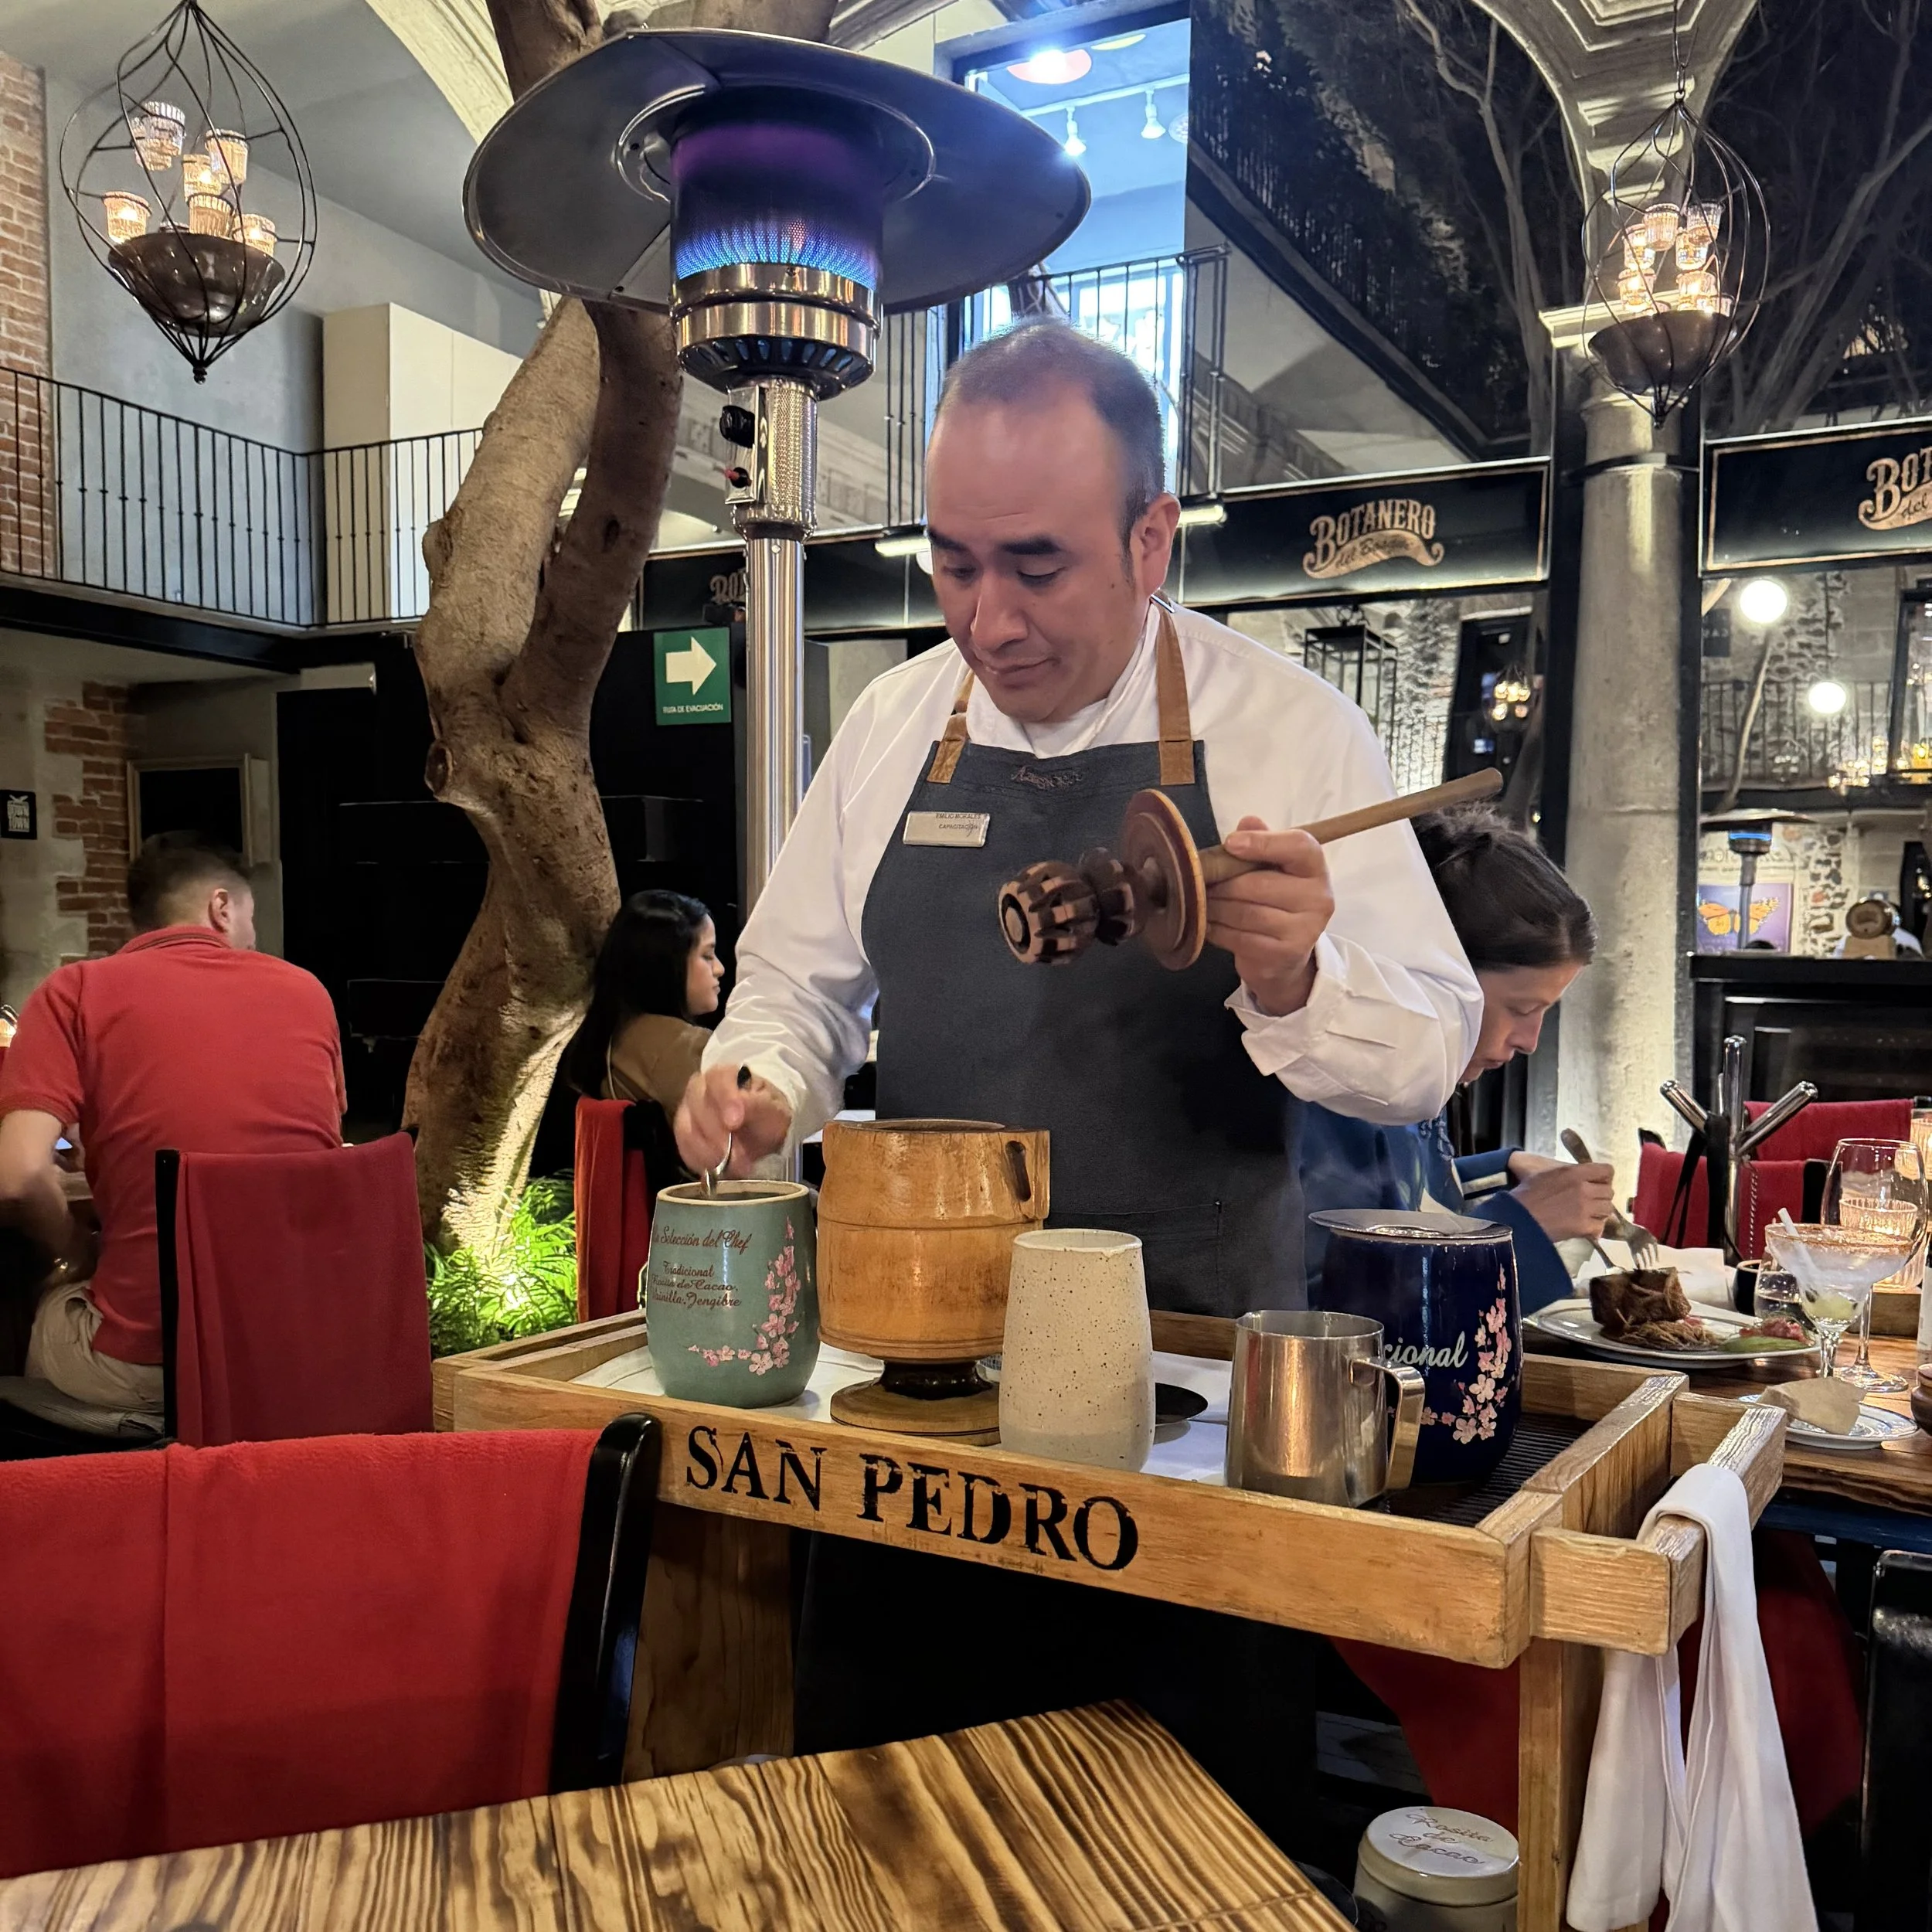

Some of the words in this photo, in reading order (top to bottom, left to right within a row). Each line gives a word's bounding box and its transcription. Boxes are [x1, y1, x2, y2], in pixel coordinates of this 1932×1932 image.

[1309, 498, 1436, 572] BOTANERO
[660, 1226, 699, 1247] Selección
[702, 1228, 723, 1248] del
[721, 1230, 753, 1255] Chef
[663, 1260, 714, 1277] Tradicional
[676, 1279, 692, 1289] de
[685, 1425, 827, 1512] SAN
[857, 1452, 1139, 1570] PEDRO
[1406, 1814, 1493, 1842] Rosita
[1423, 1832, 1464, 1844] de
[1389, 1832, 1485, 1864] Cacao
